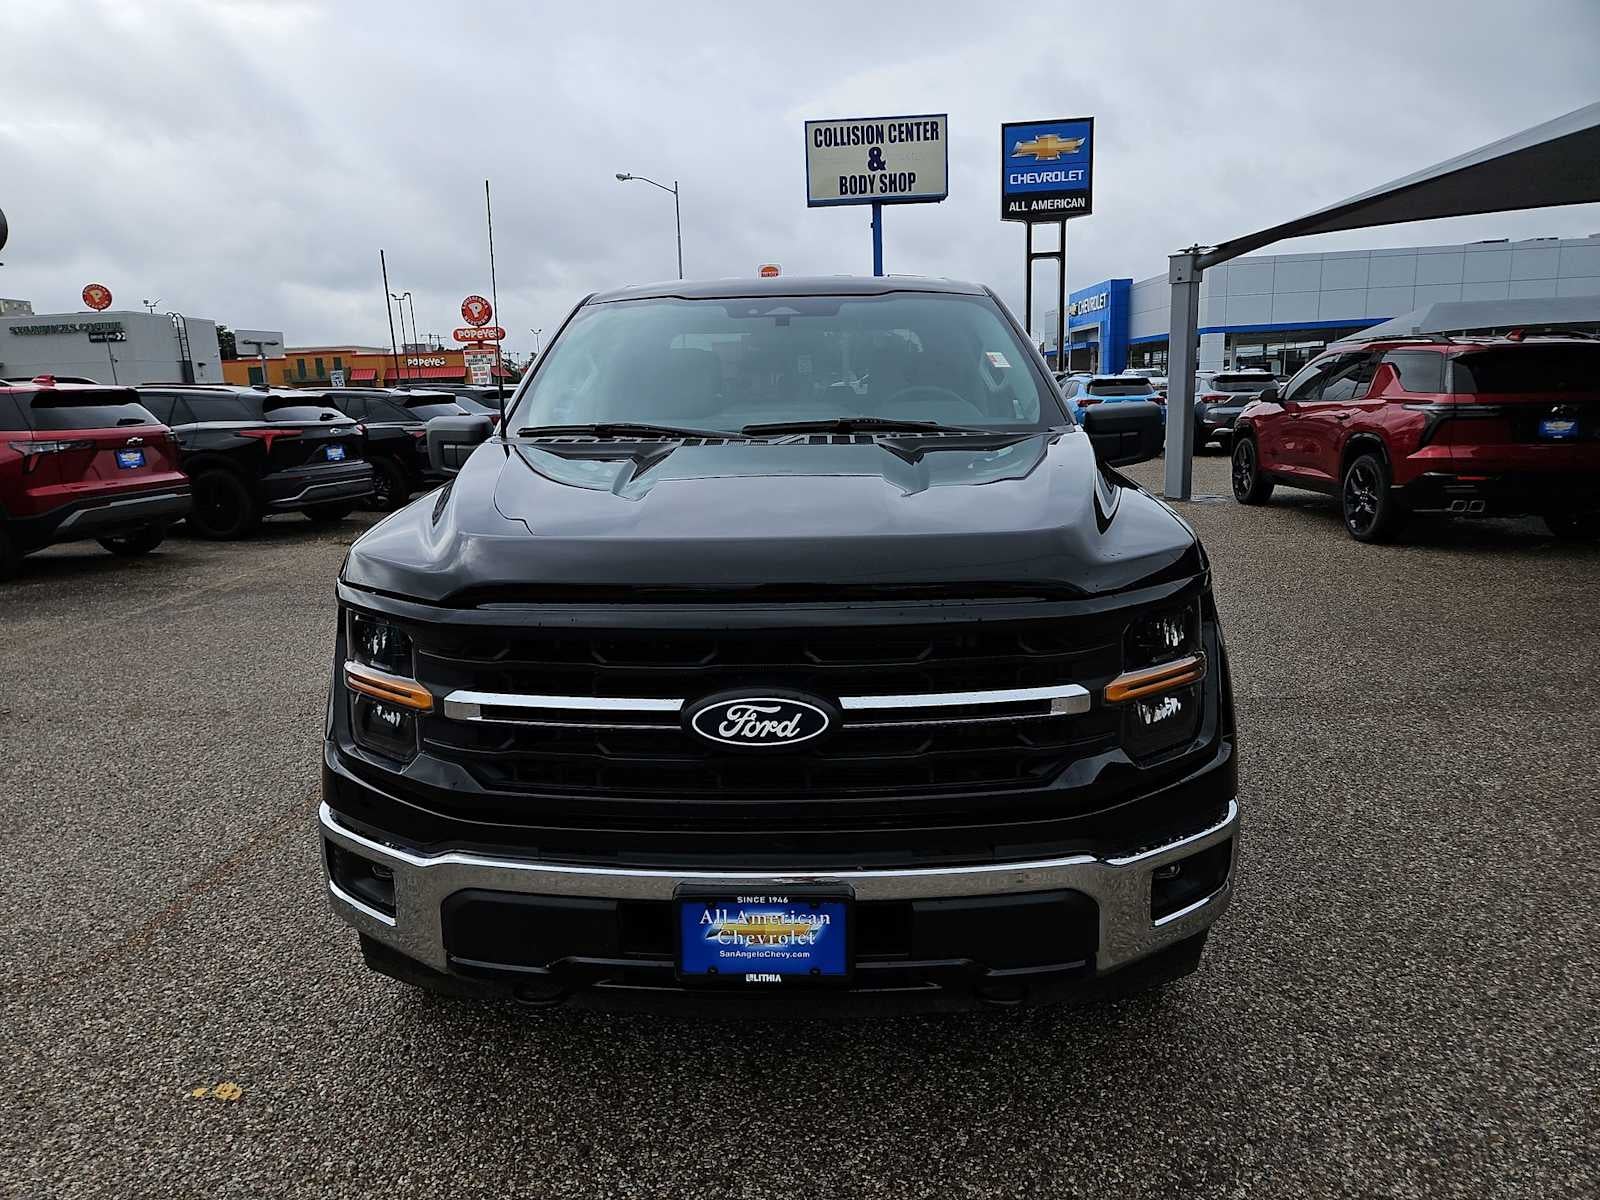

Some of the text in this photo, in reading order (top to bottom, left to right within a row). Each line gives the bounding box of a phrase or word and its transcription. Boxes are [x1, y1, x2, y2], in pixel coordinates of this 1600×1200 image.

[814, 121, 939, 148] COLLISION CENTER
[867, 147, 886, 171] &
[839, 172, 916, 195] BODY SHOP
[1009, 169, 1085, 185] CHEVROLET
[1009, 197, 1086, 212] ALL AMERICAN
[719, 704, 802, 737] Ford
[737, 896, 789, 904] SINCE 1946
[700, 909, 831, 925] All American
[718, 929, 816, 946] Chevrolet
[719, 950, 811, 959] SanAngeloChevy.com
